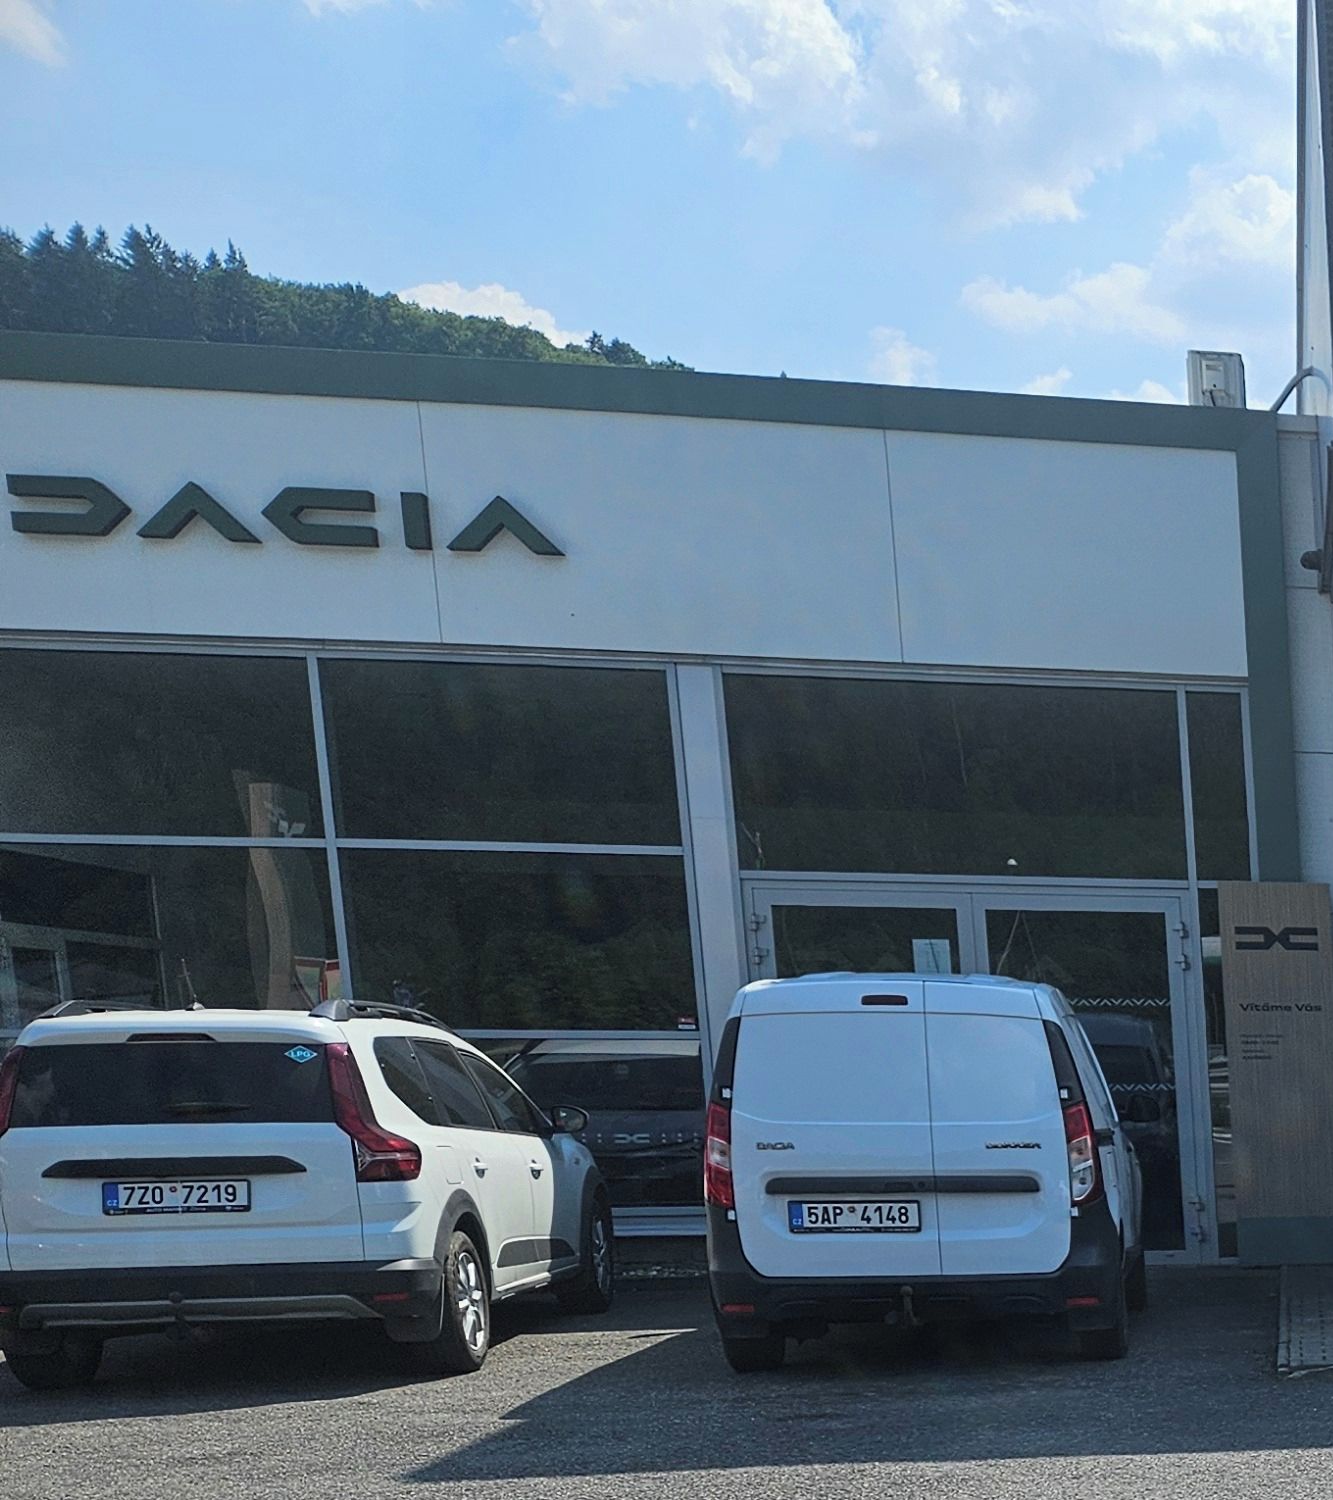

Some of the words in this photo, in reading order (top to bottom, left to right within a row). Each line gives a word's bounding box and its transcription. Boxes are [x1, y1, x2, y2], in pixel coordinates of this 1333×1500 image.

[6, 473, 566, 556] DACIA
[290, 1050, 311, 1058] LPG
[123, 1186, 164, 1205] 7Z0
[181, 1184, 237, 1204] 7219
[807, 1206, 844, 1225] 5AP
[860, 1206, 910, 1224] 4148
